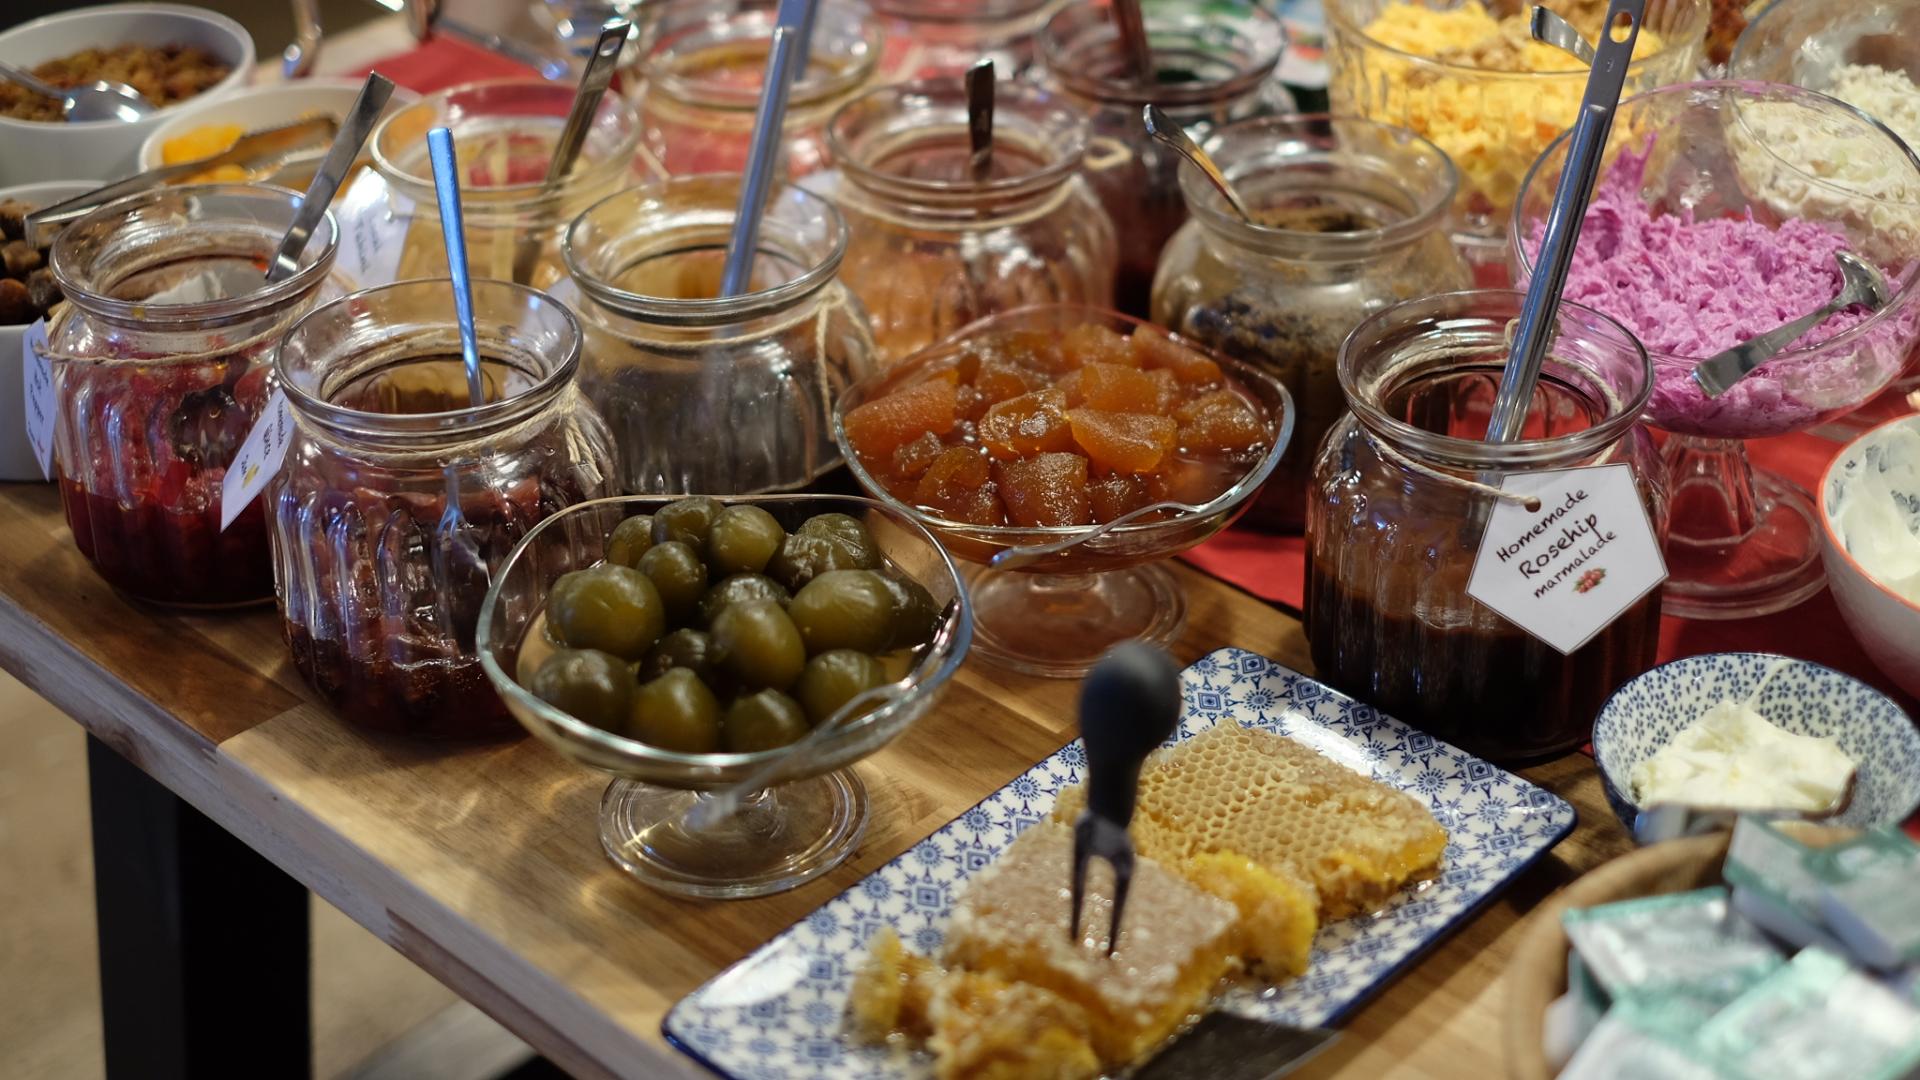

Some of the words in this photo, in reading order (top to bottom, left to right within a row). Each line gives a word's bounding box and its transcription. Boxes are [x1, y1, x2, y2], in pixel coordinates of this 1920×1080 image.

[1496, 488, 1589, 562] Homemade
[1519, 513, 1601, 579] Rosehip
[1534, 530, 1617, 599] marmalade
